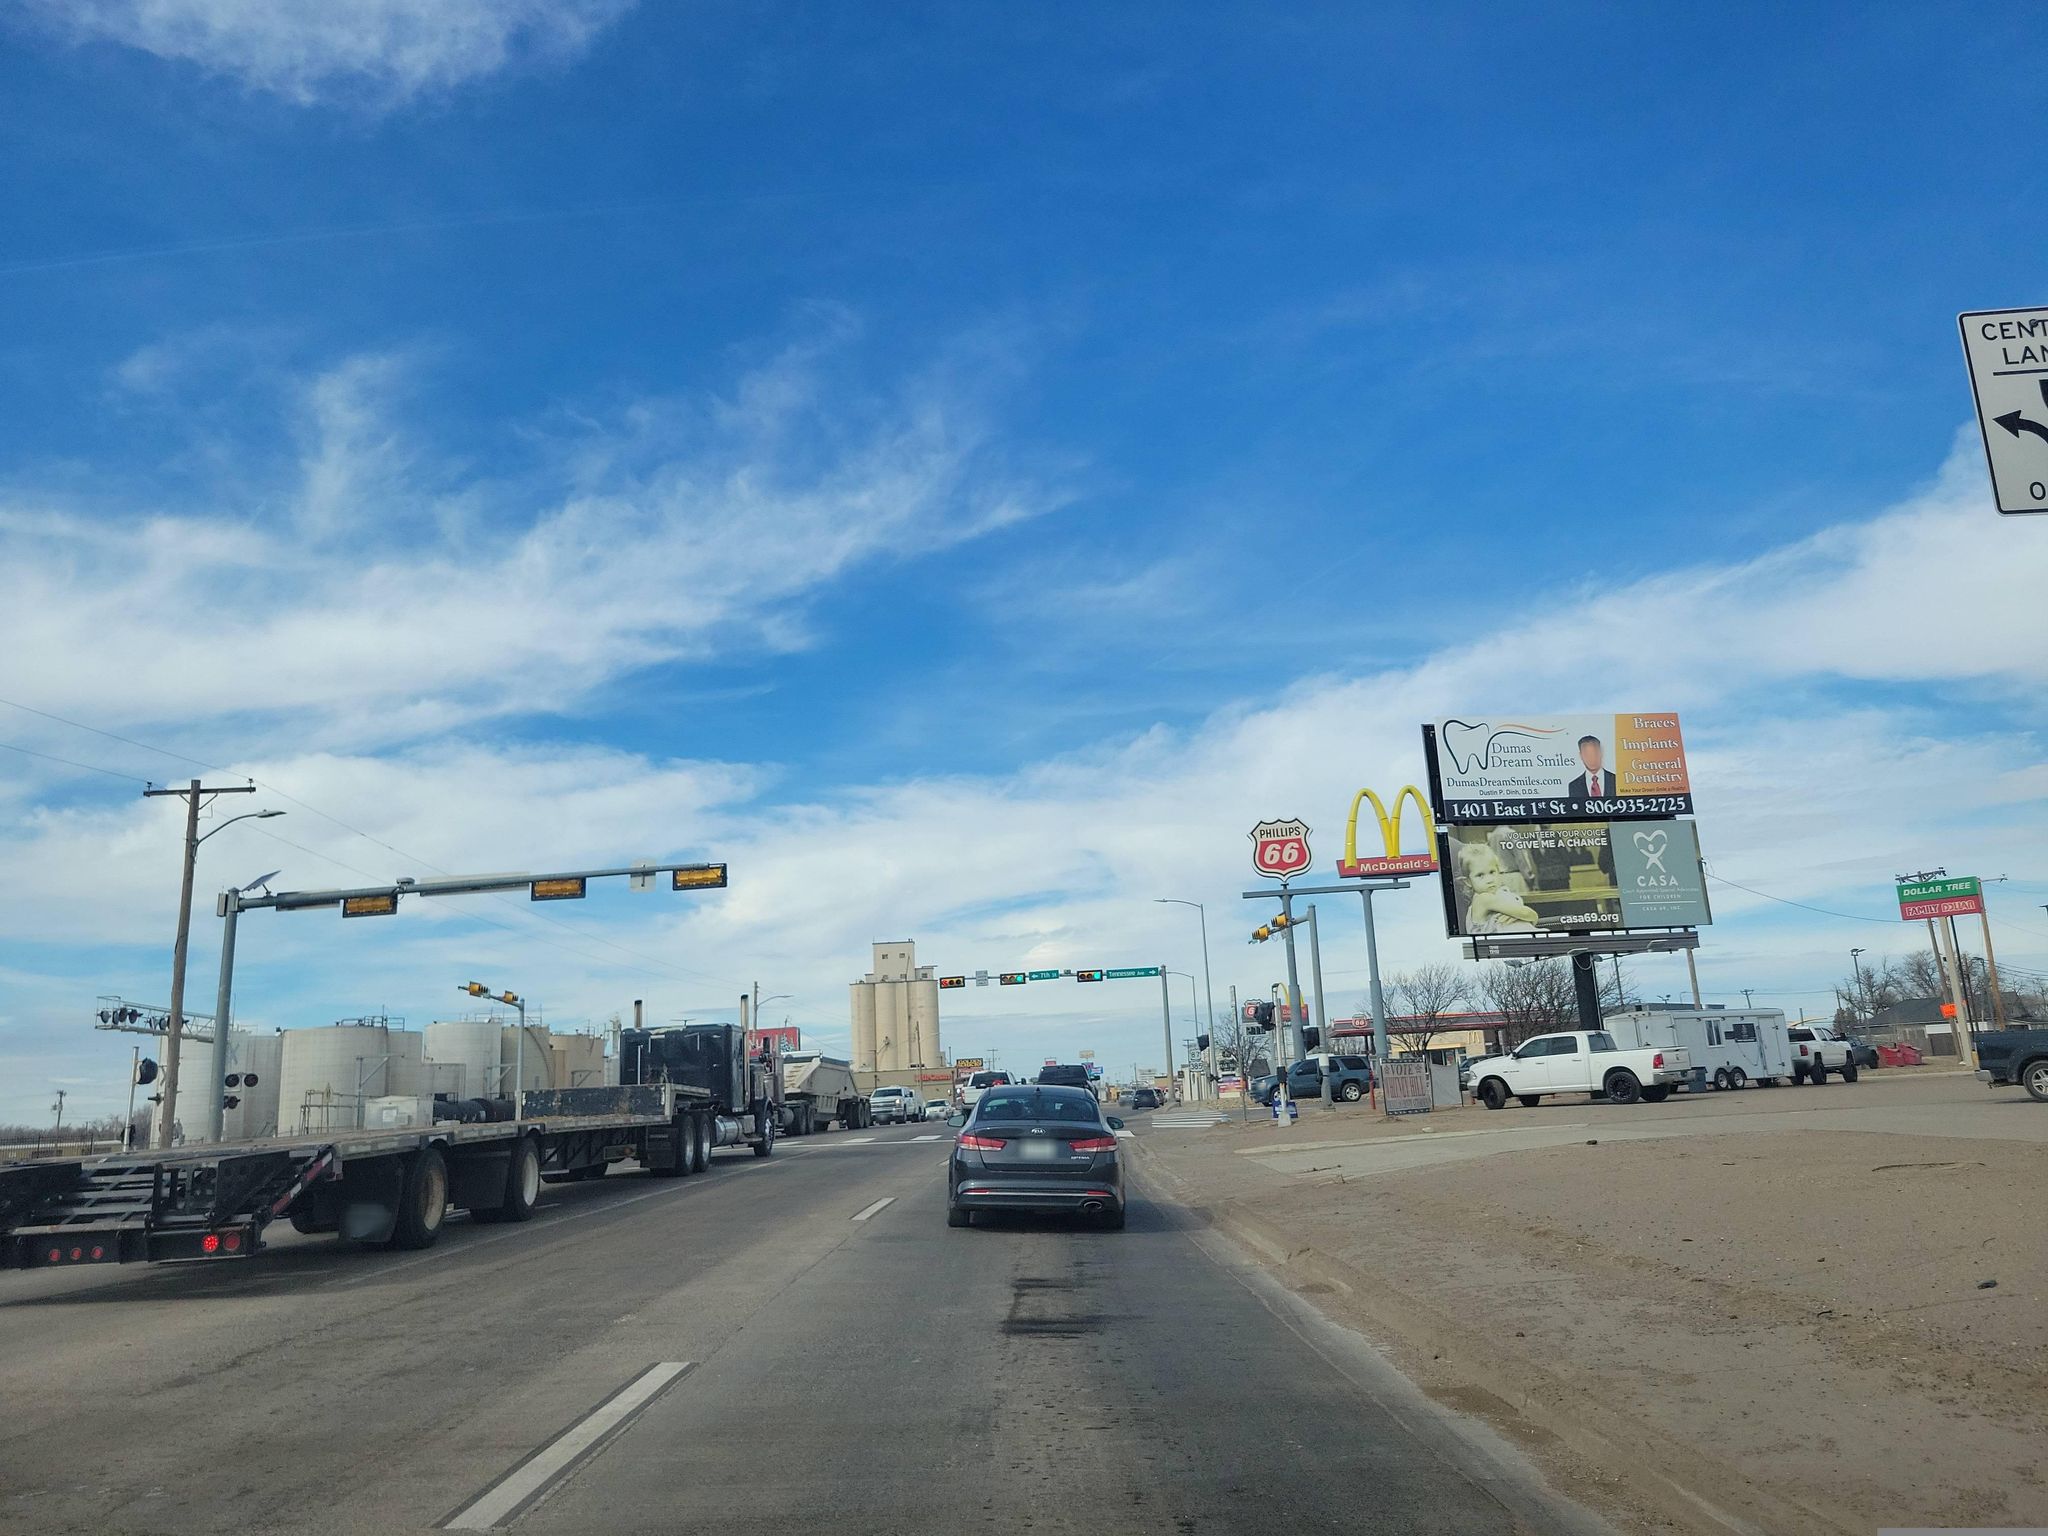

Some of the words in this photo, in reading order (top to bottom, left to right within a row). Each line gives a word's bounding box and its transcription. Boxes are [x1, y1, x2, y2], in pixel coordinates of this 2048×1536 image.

[1633, 717, 1676, 729] Braces
[1491, 742, 1532, 754] Dumas
[1622, 737, 1679, 752] Implants
[1491, 755, 1533, 768] Dream
[1536, 753, 1576, 767] Smiles
[1631, 757, 1682, 770] General
[1446, 776, 1562, 787] DumasDreamSmiles.com
[1624, 771, 1683, 784] Dentistry
[1452, 803, 1489, 818] 1401
[1493, 801, 1526, 817] East
[1531, 801, 1546, 815] 1st
[1549, 800, 1567, 815] St
[1585, 796, 1686, 814] 806-935-2725
[1259, 826, 1301, 839] PHILLIPS
[1507, 831, 1556, 840] VOLUNTEER
[1557, 830, 1580, 838] YOUR
[1580, 829, 1606, 837] VOICE
[1500, 841, 1513, 850] TO
[1515, 840, 1540, 849] GIVE
[1541, 839, 1556, 848] ME
[1557, 839, 1566, 848] A
[1567, 837, 1608, 847] CHANCE
[1263, 842, 1300, 865] 66
[1360, 859, 1430, 872] McDonald's
[1637, 875, 1679, 886] CASA
[1903, 885, 1942, 896] DOLLAR
[1945, 882, 1971, 891] TREE
[1906, 903, 1939, 916] FAMILY
[1941, 900, 1976, 912] DOLLAR
[1560, 912, 1620, 925] casa69.org
[1391, 1063, 1414, 1076] VOTE
